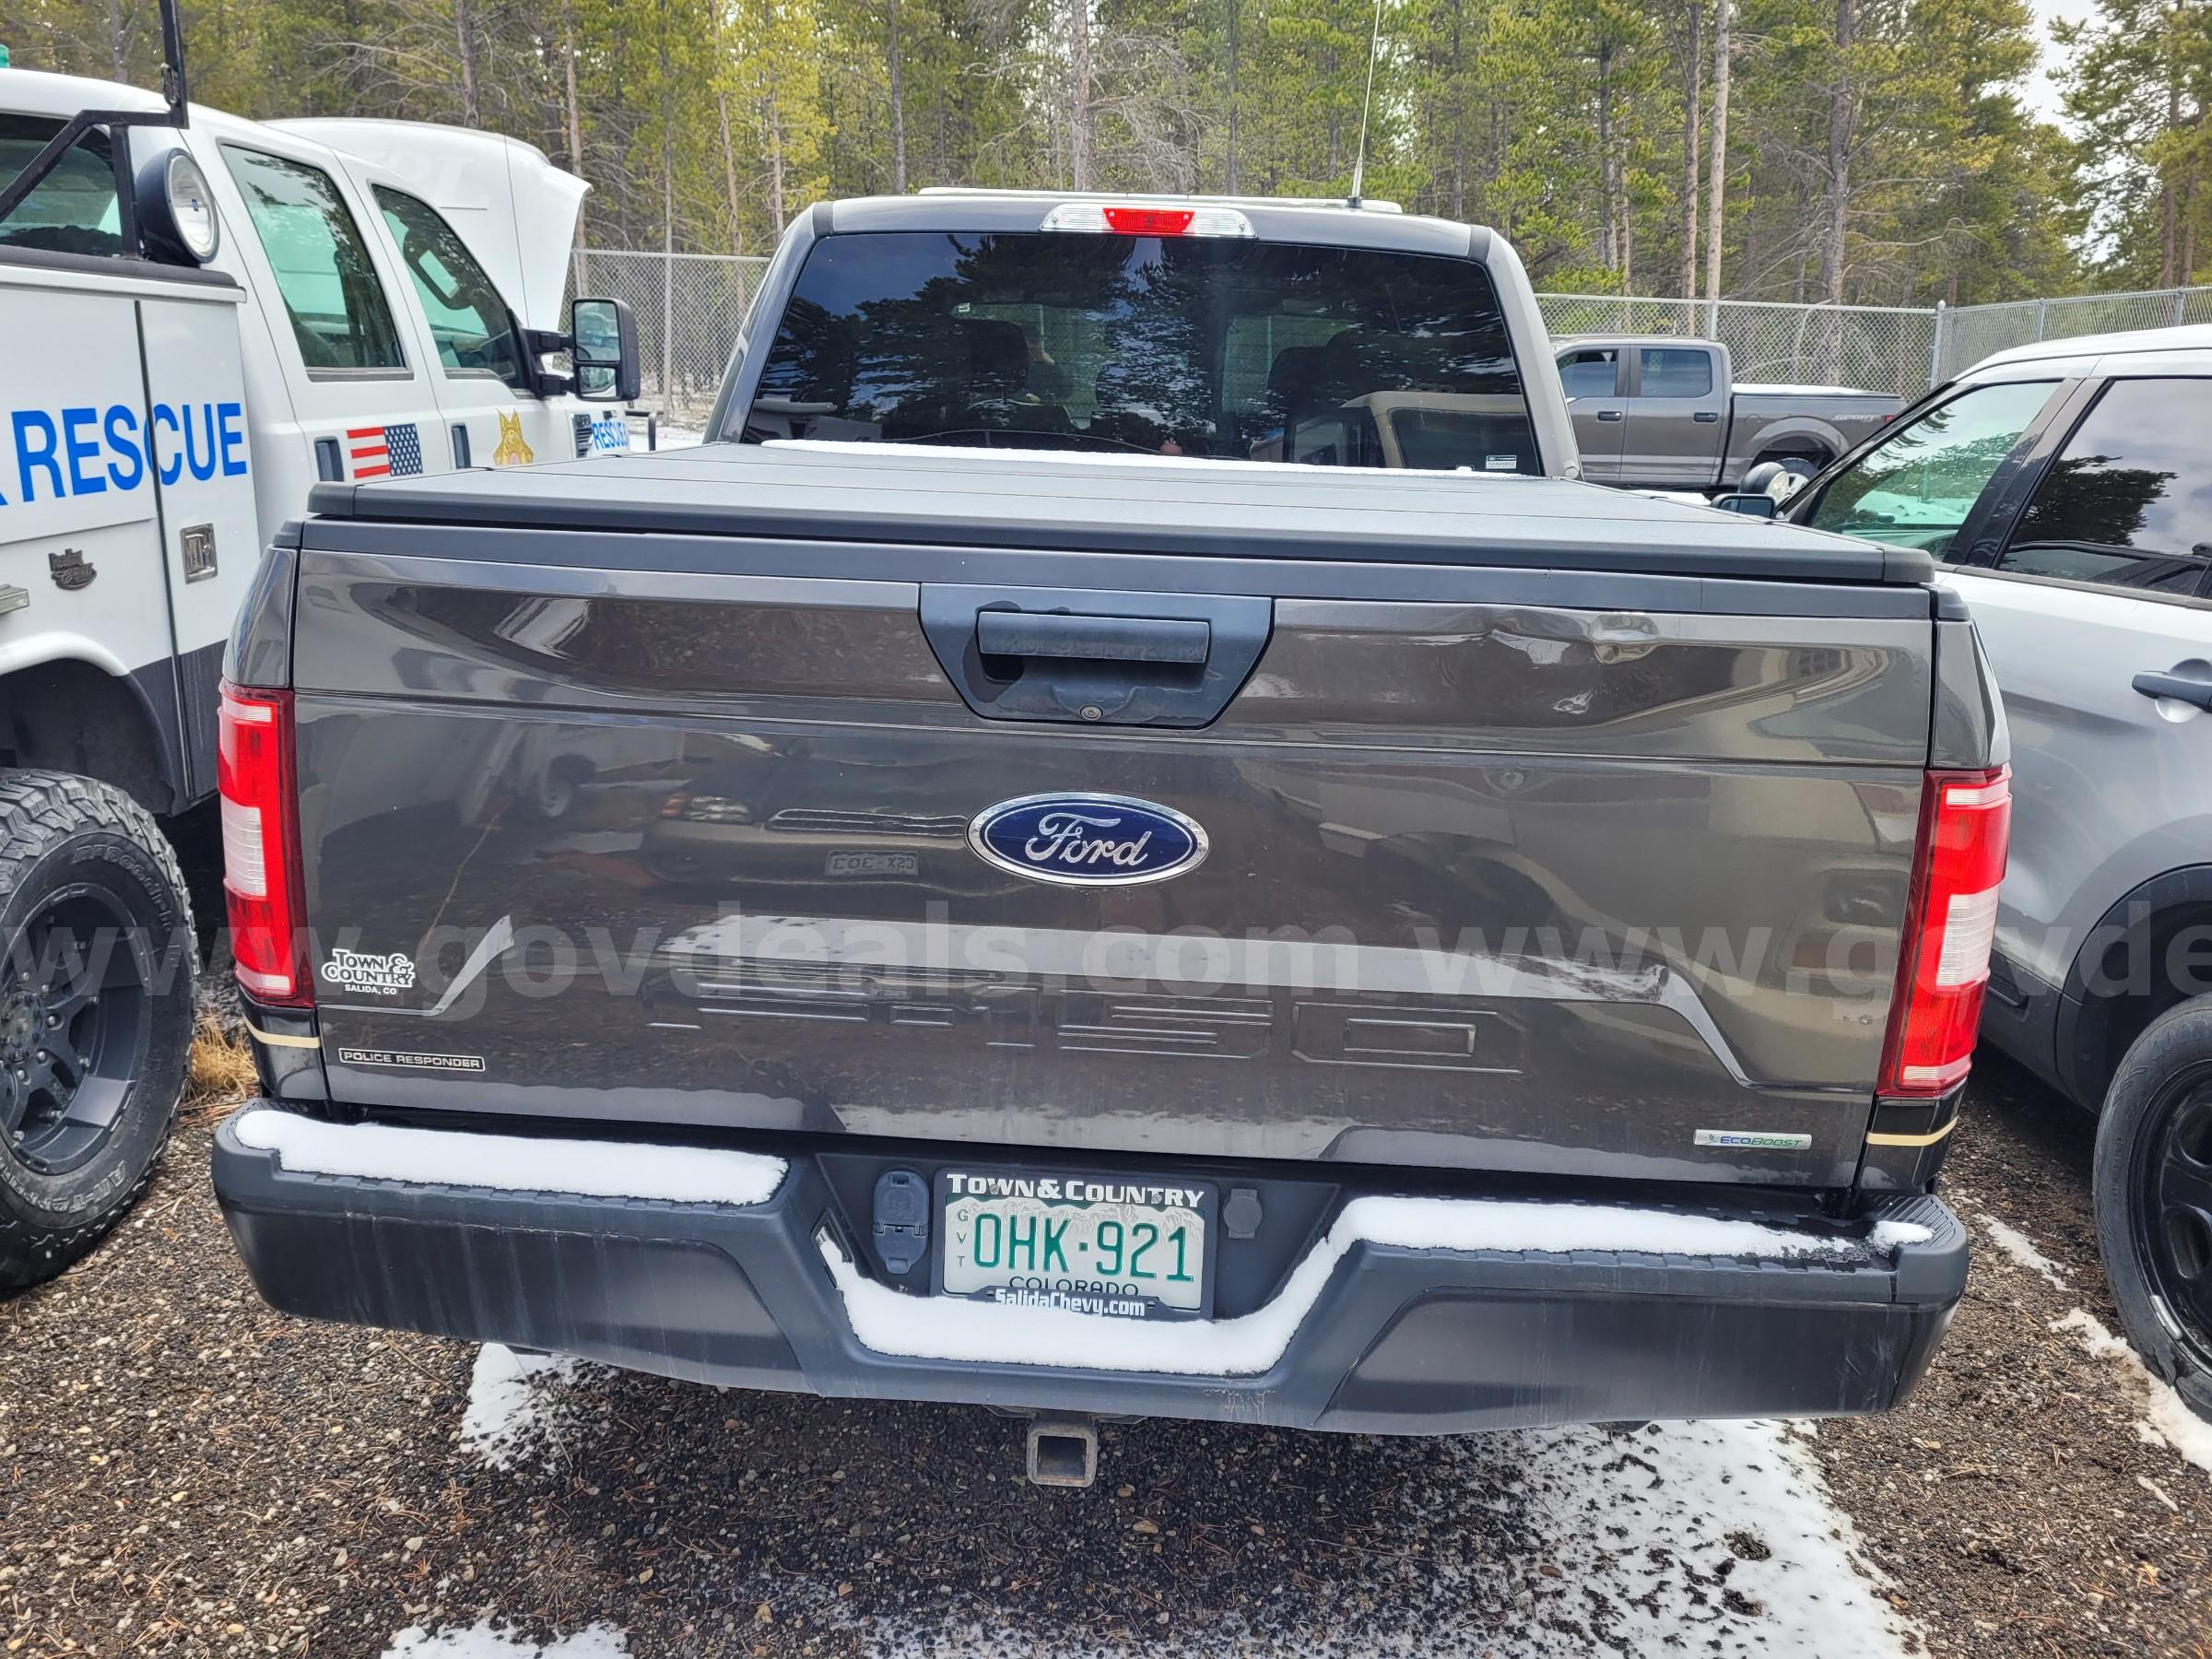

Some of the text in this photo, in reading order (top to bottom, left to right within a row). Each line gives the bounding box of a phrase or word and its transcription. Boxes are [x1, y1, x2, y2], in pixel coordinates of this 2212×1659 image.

[11, 403, 247, 502] RESCUE
[1024, 811, 1154, 868] Ford
[334, 950, 385, 970] TOWN
[323, 964, 413, 985] COUNTRY
[345, 984, 397, 995] SALIDA, CO
[344, 1052, 480, 1068] POLICE RESPONDER
[1720, 1135, 1804, 1147] ECOBOOST
[1008, 1276, 1140, 1297] COLORADO
[994, 1288, 1147, 1317] SalidaChevy.com
